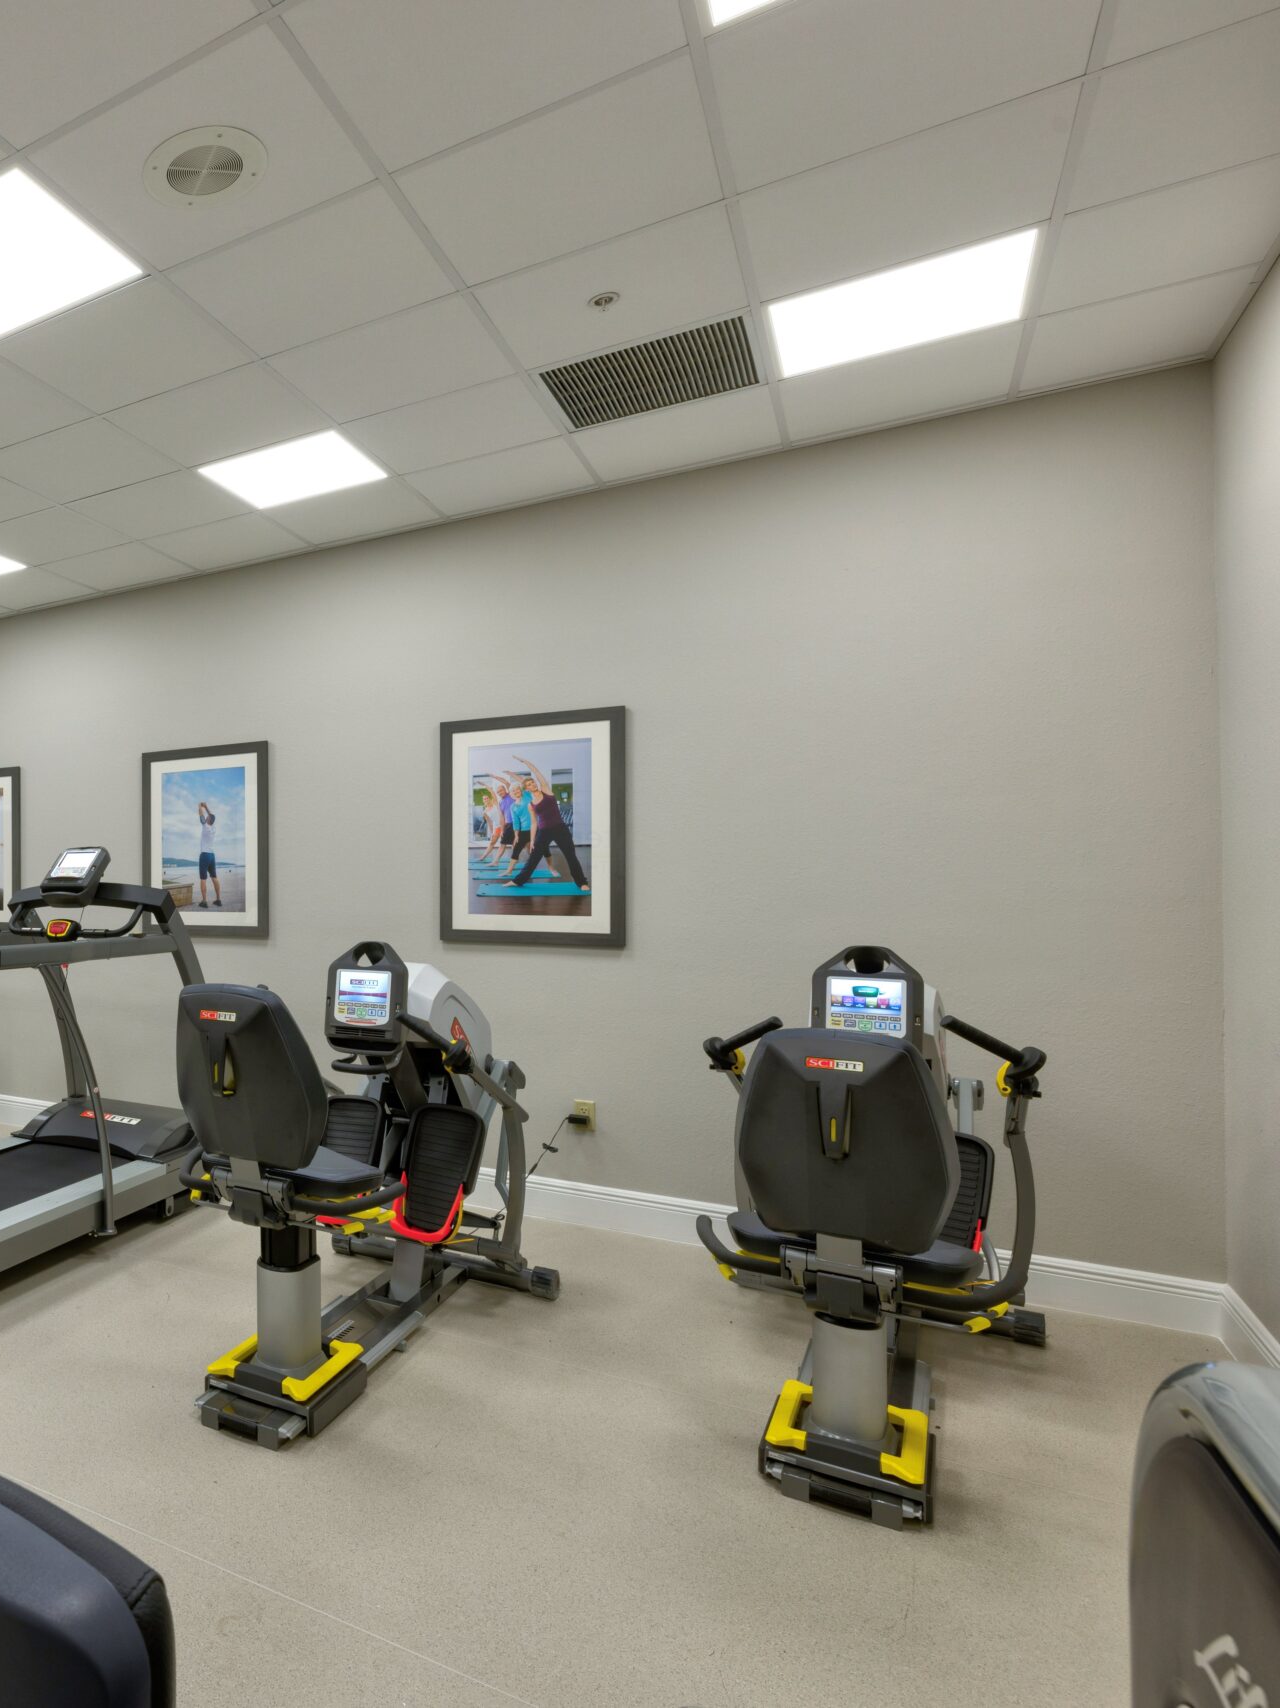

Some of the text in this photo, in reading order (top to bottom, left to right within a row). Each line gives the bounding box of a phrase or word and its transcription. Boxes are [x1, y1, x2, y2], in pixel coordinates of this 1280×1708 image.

[201, 1010, 236, 1021] SCIFIT
[809, 1058, 862, 1070] SCIFIT
[83, 1110, 138, 1123] SIFIT
